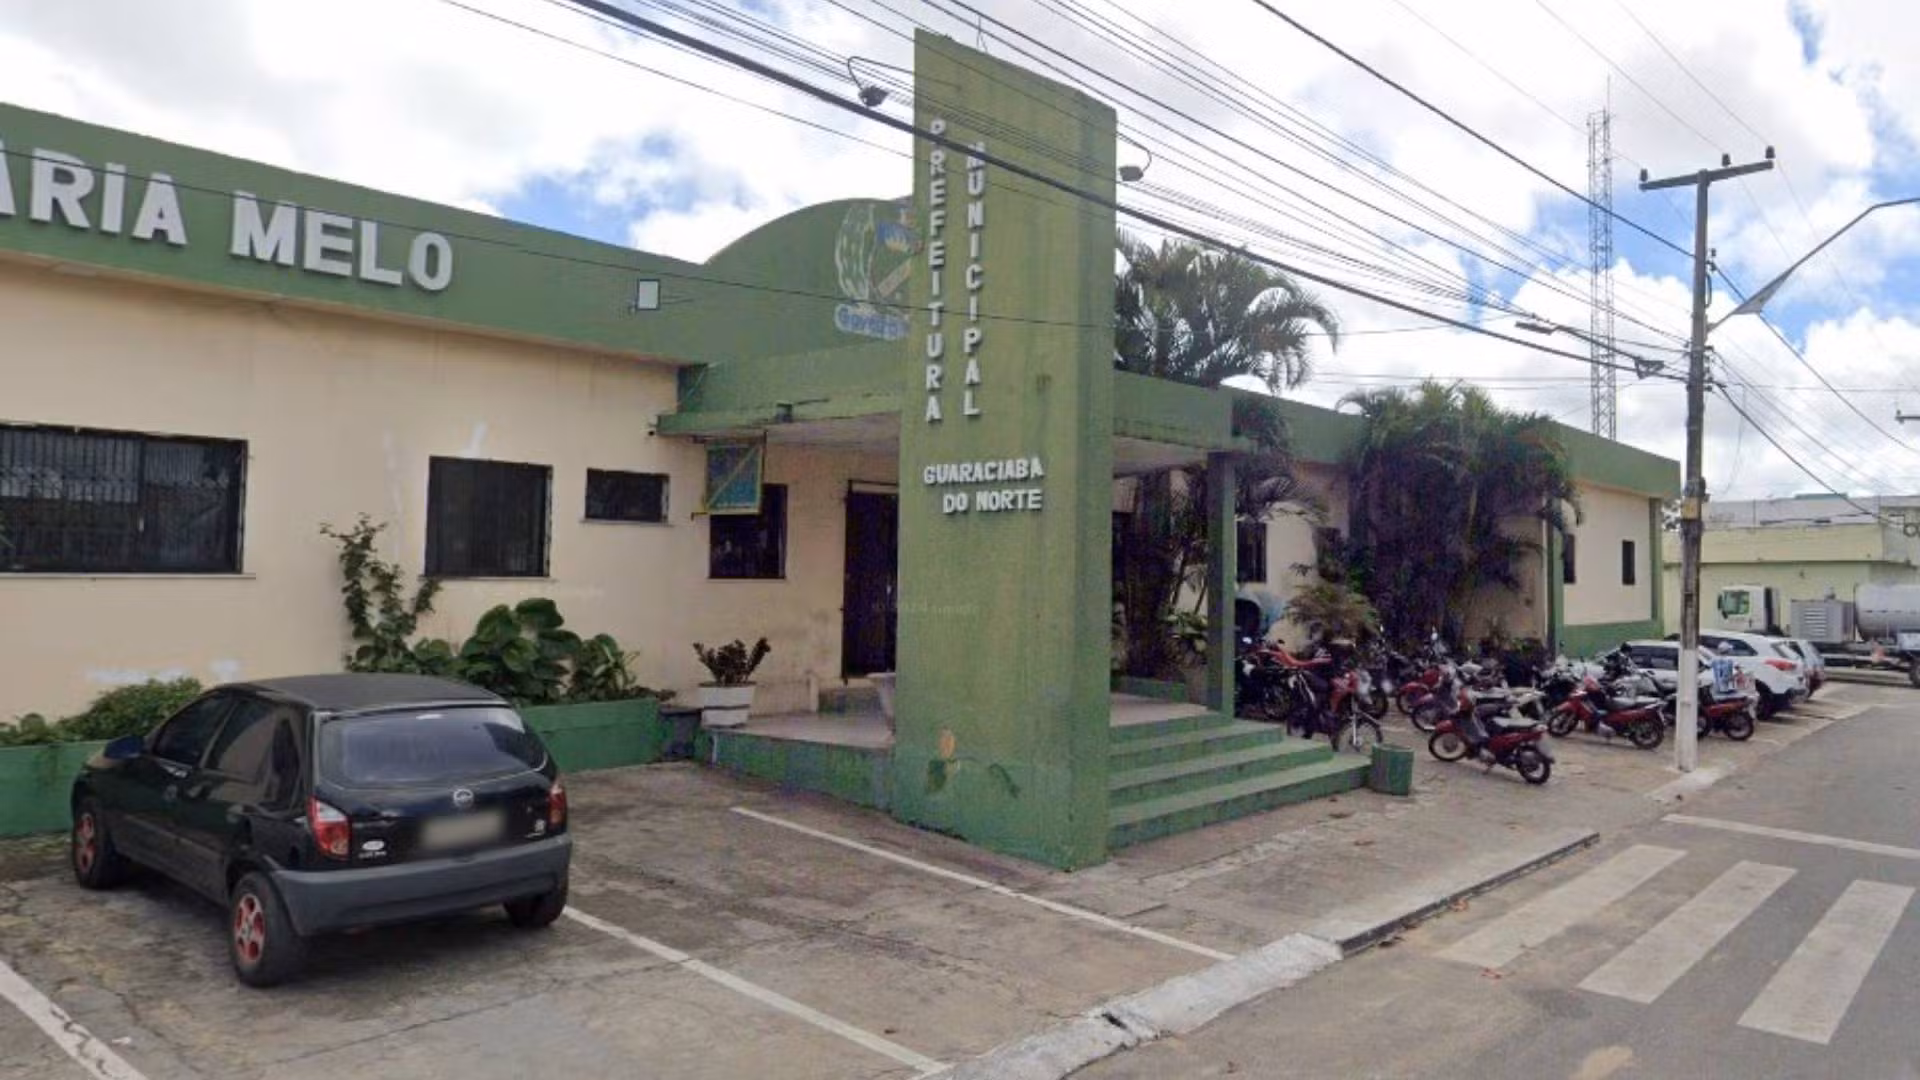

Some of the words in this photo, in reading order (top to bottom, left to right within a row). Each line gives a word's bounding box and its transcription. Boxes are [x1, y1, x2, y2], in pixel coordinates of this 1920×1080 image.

[0, 138, 188, 246] RIA
[231, 190, 453, 292] MELO
[926, 119, 946, 421] PREFEITURA
[963, 142, 985, 415] MUNICIPAL
[924, 457, 1044, 485] GUARACIABA
[943, 493, 969, 513] DO
[975, 488, 1043, 512] NORTE
